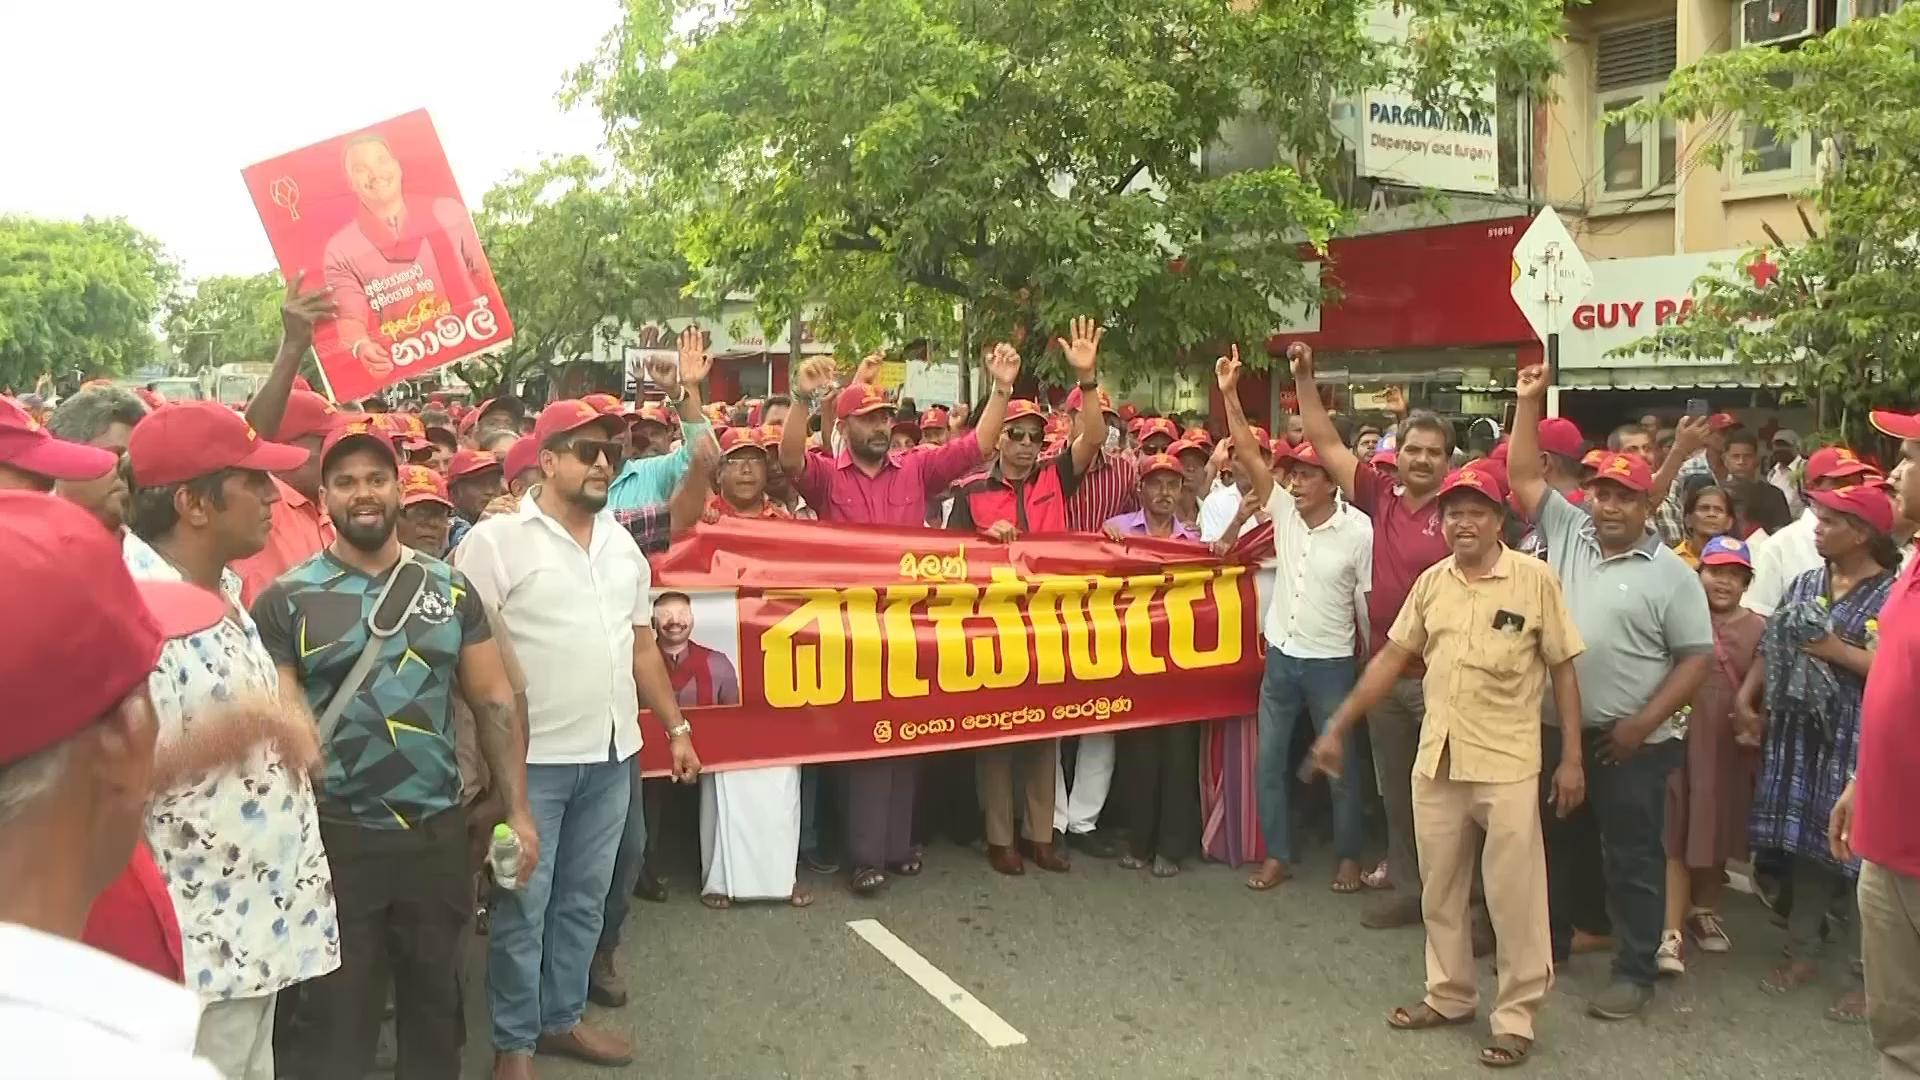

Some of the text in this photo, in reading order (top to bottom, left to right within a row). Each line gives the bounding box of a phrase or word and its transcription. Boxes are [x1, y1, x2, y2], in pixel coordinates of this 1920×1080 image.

[1371, 133, 1493, 162] Dispensary and Surgery
[391, 295, 498, 366] නාමල්
[1572, 301, 1644, 330] GUY
[873, 697, 1132, 743] ශ්‍රී ලංකා පොදුජන පෙරමුණ
